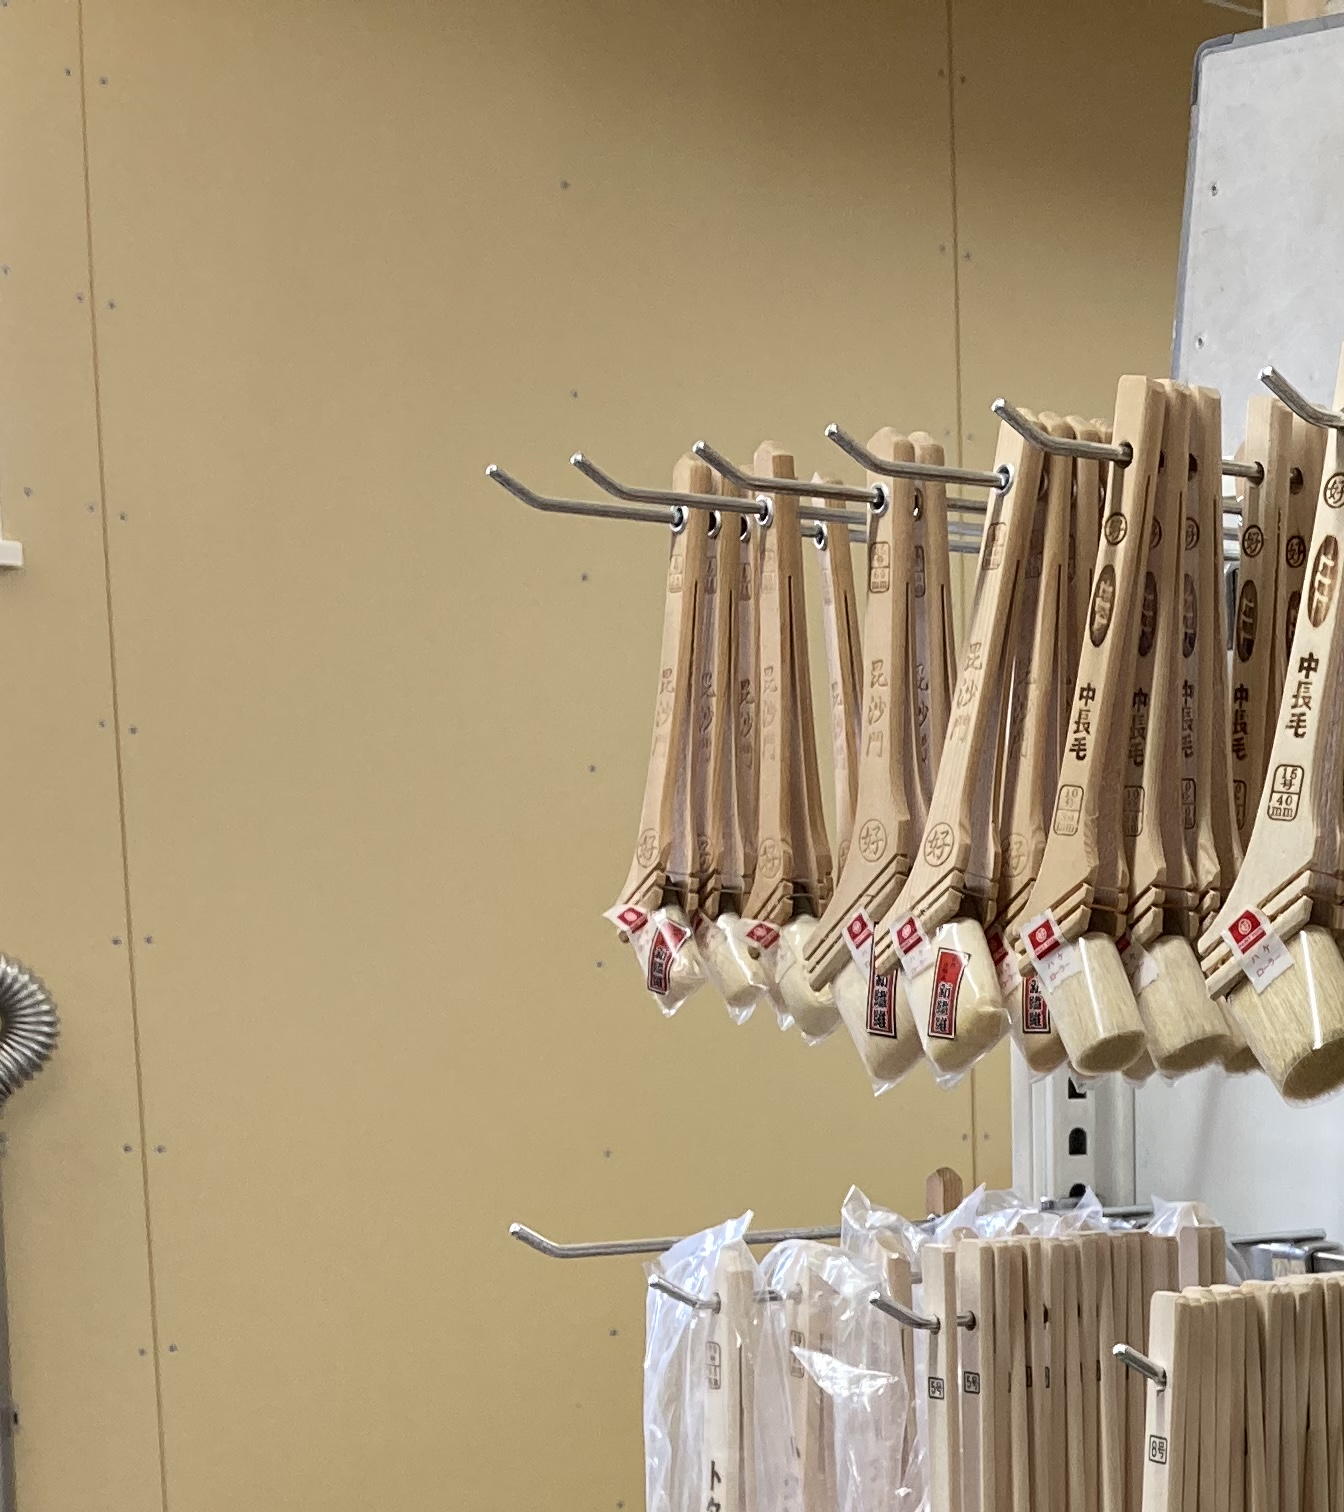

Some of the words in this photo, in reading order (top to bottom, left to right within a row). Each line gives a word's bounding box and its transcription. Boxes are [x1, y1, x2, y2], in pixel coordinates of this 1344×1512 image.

[1285, 652, 1320, 738] 中長毛
[1069, 682, 1096, 761] 中長毛
[860, 821, 886, 860] 好
[926, 825, 952, 863] 好
[1150, 1440, 1166, 1461] 8号
